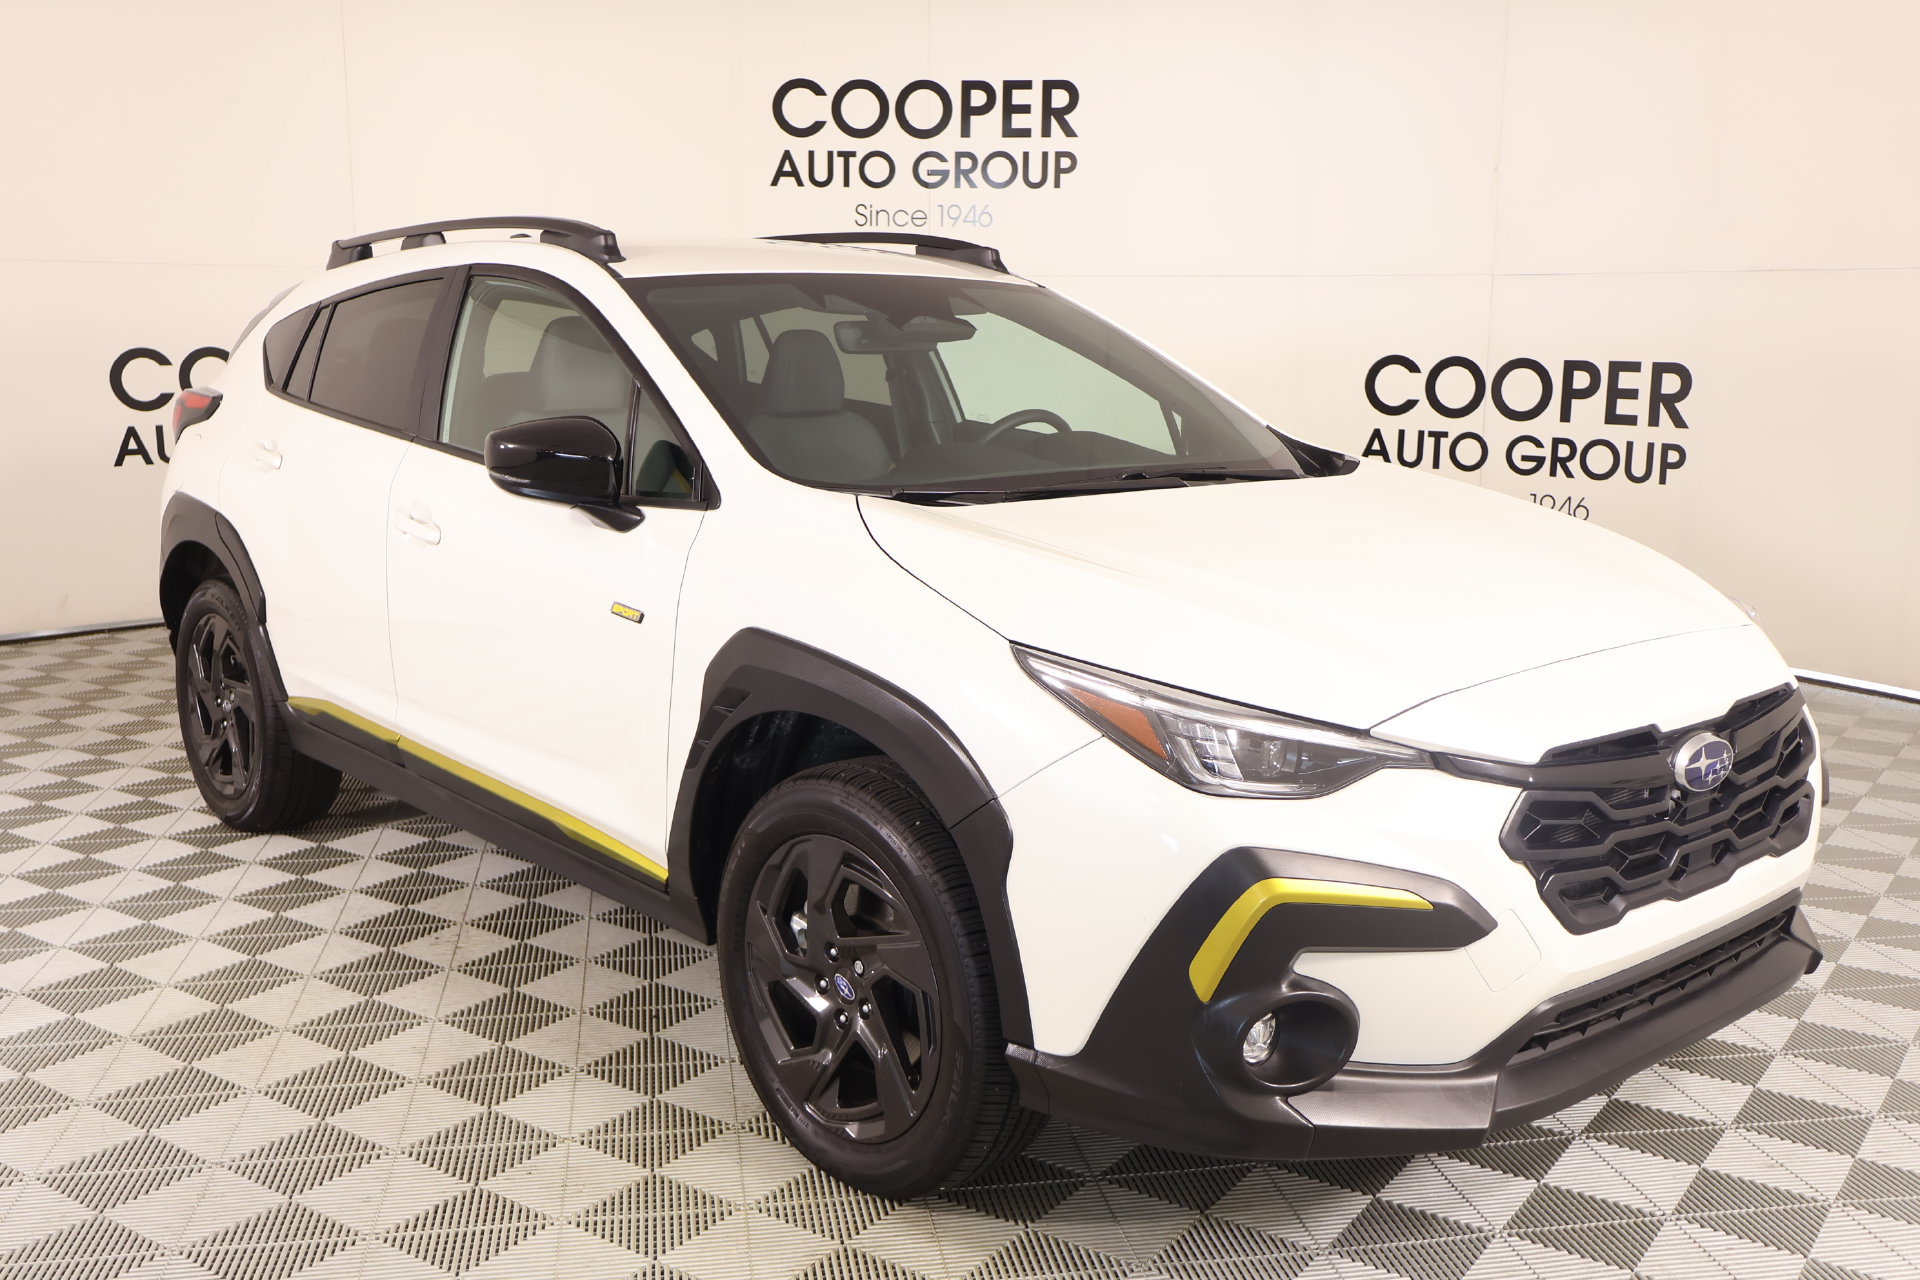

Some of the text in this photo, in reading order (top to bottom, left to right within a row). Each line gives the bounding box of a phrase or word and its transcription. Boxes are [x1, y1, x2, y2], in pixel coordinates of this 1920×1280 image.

[772, 78, 1079, 139] COOPER
[770, 150, 1077, 189] AUTO GROUP
[855, 204, 993, 227] Since 1946
[1365, 354, 1692, 429] COOPER
[1362, 428, 1687, 485] AUTO GROUP
